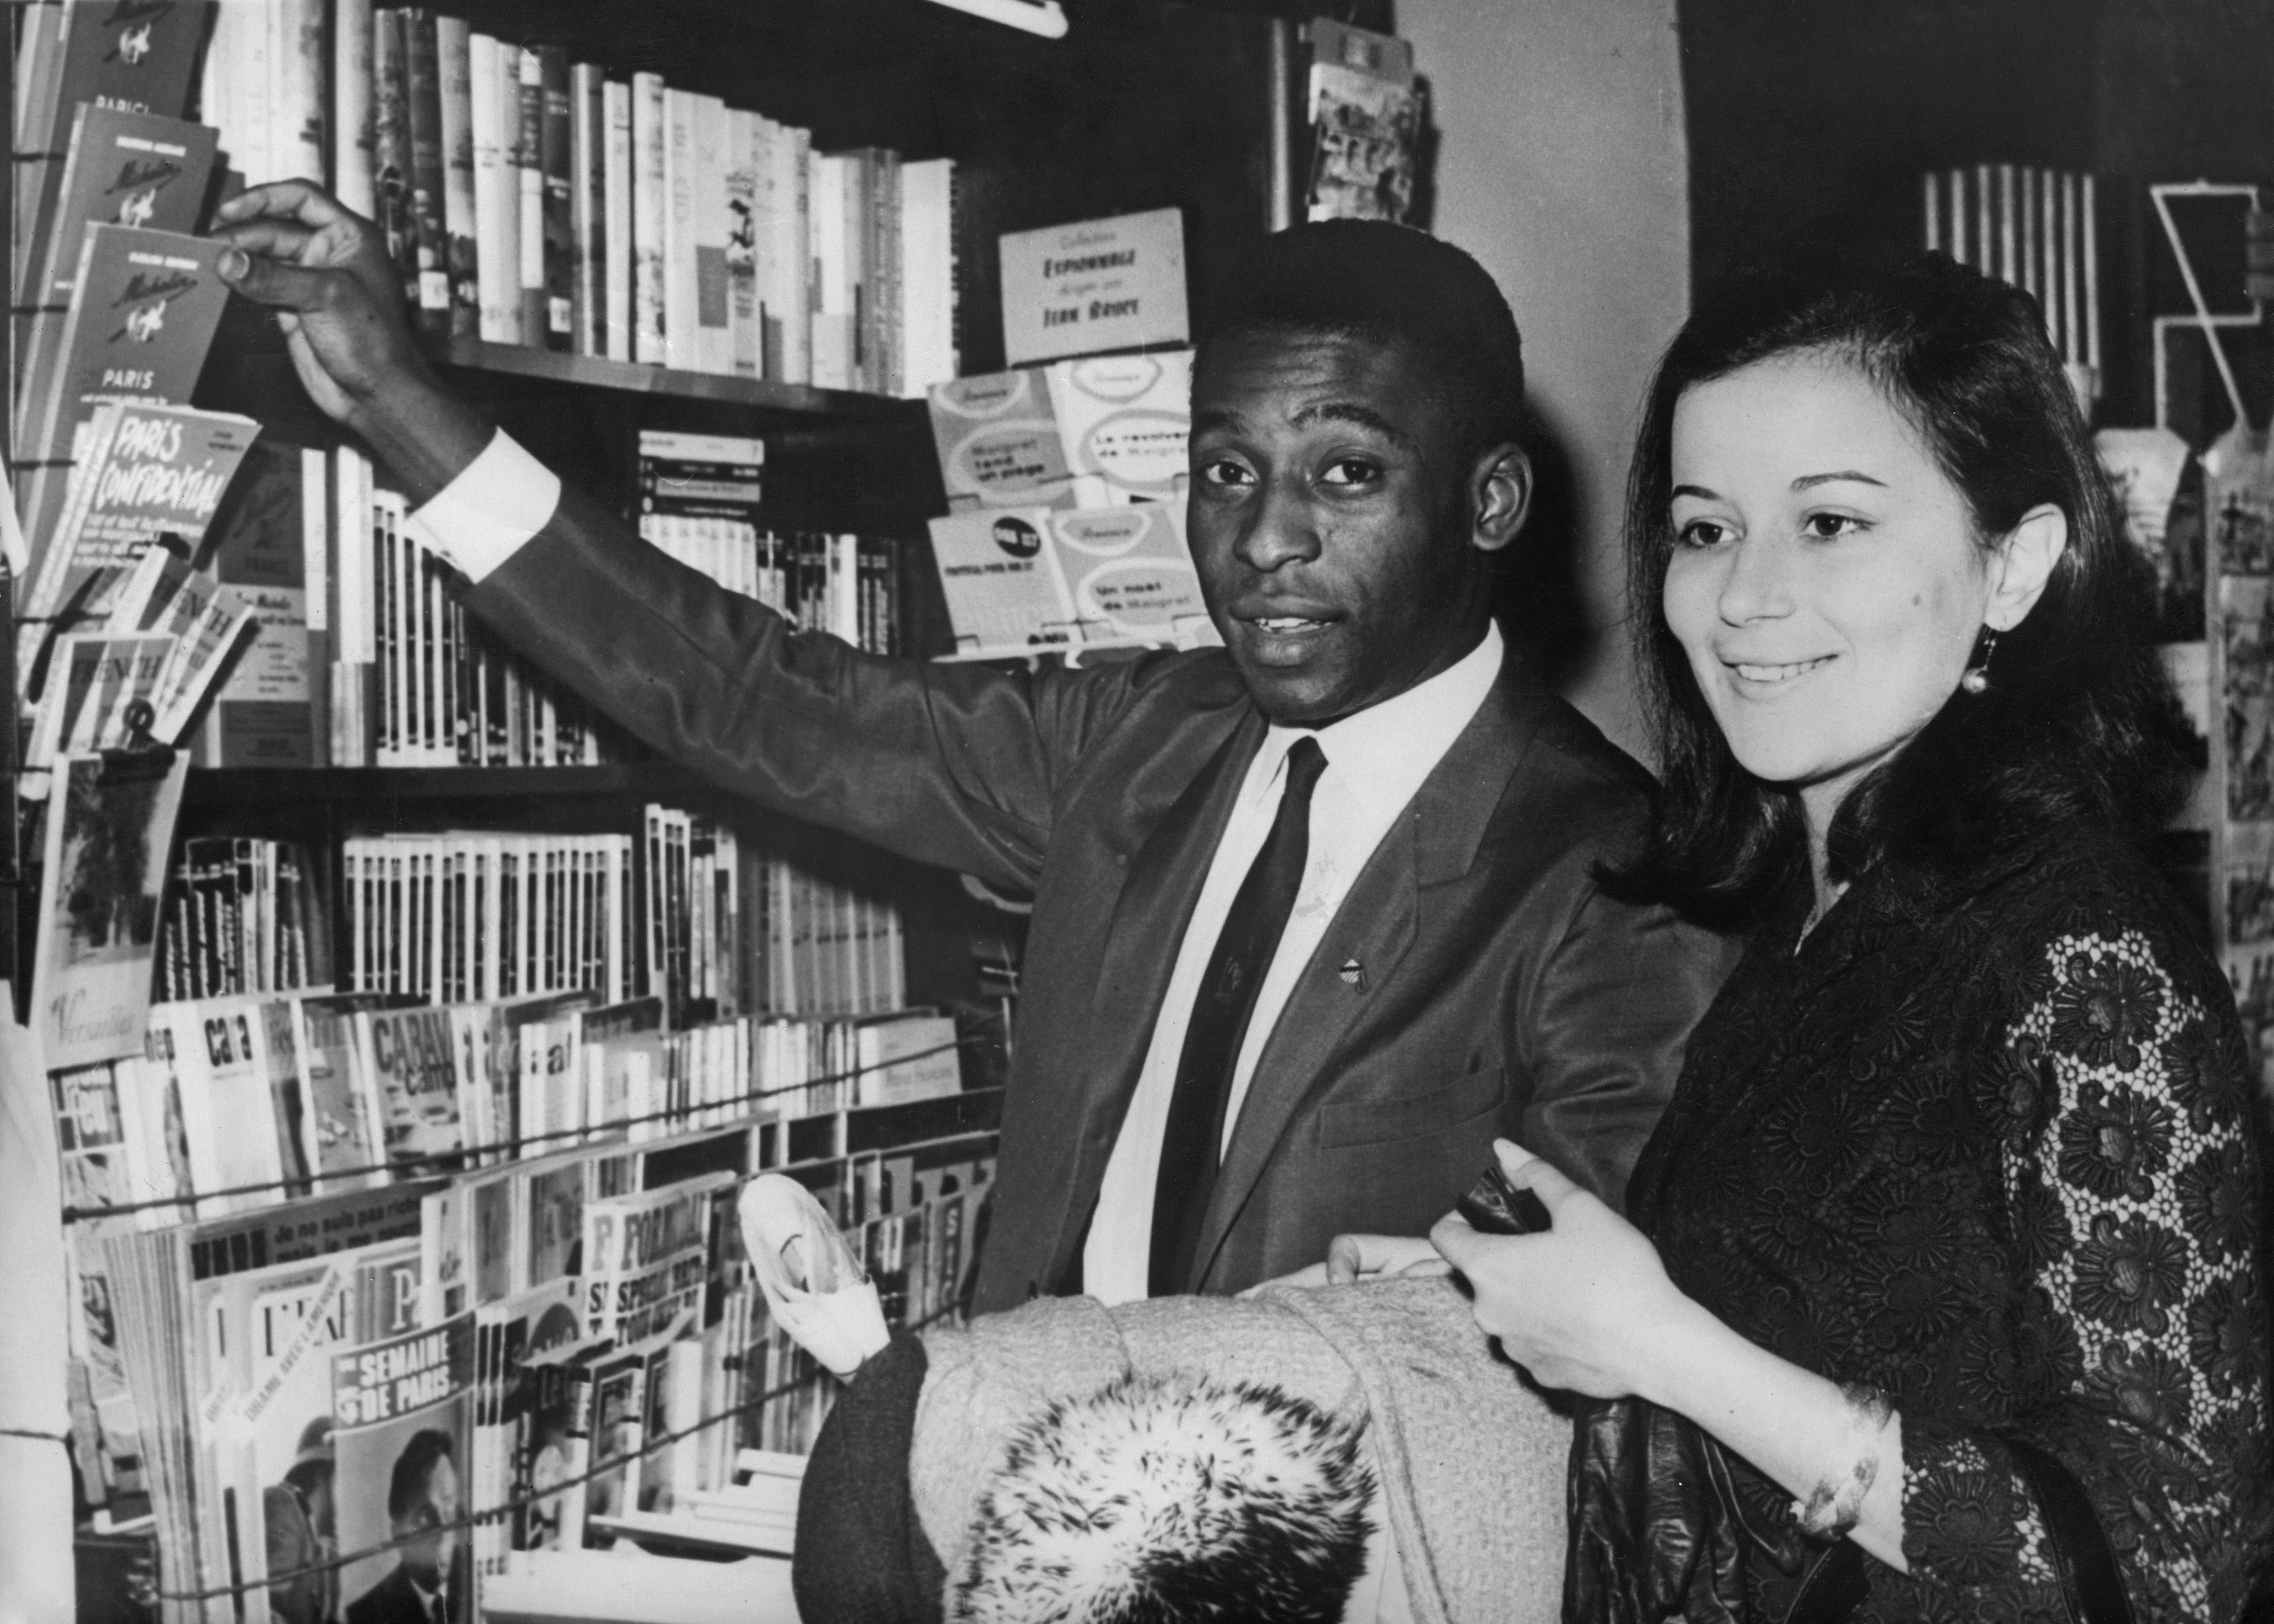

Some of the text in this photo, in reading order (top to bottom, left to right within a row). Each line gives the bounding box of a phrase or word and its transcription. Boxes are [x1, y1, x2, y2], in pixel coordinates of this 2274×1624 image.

[102, 368, 154, 389] PARIS
[276, 1224, 294, 1244] Je
[298, 1221, 317, 1237] ne
[322, 1210, 354, 1233] suis
[358, 1206, 384, 1228] pas
[360, 1330, 449, 1387] SEMAINE
[361, 1384, 390, 1422] DE
[397, 1364, 450, 1411] PARIS
